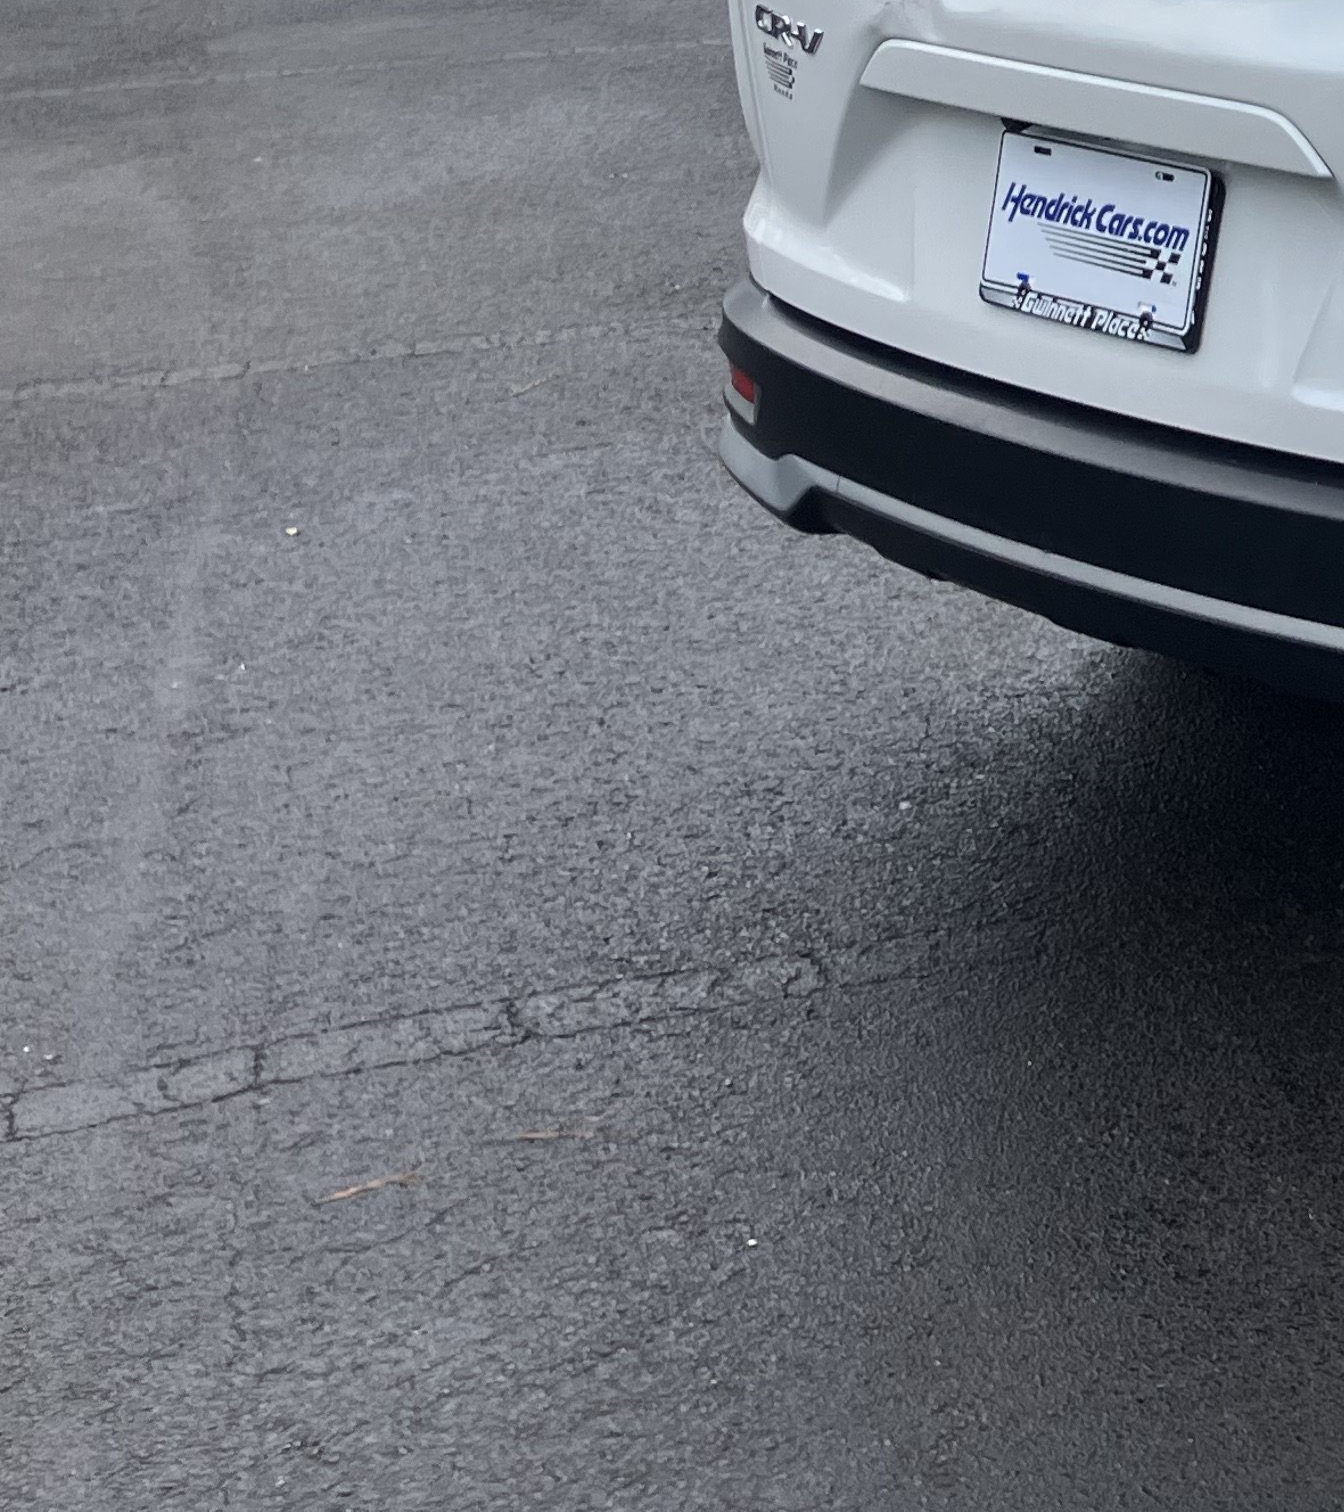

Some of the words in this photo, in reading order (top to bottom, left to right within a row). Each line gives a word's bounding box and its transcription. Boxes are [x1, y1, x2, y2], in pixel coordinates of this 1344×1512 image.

[755, 4, 824, 55] CR-V
[1021, 291, 1091, 328] Gwinnett
[1091, 309, 1140, 339] Place
